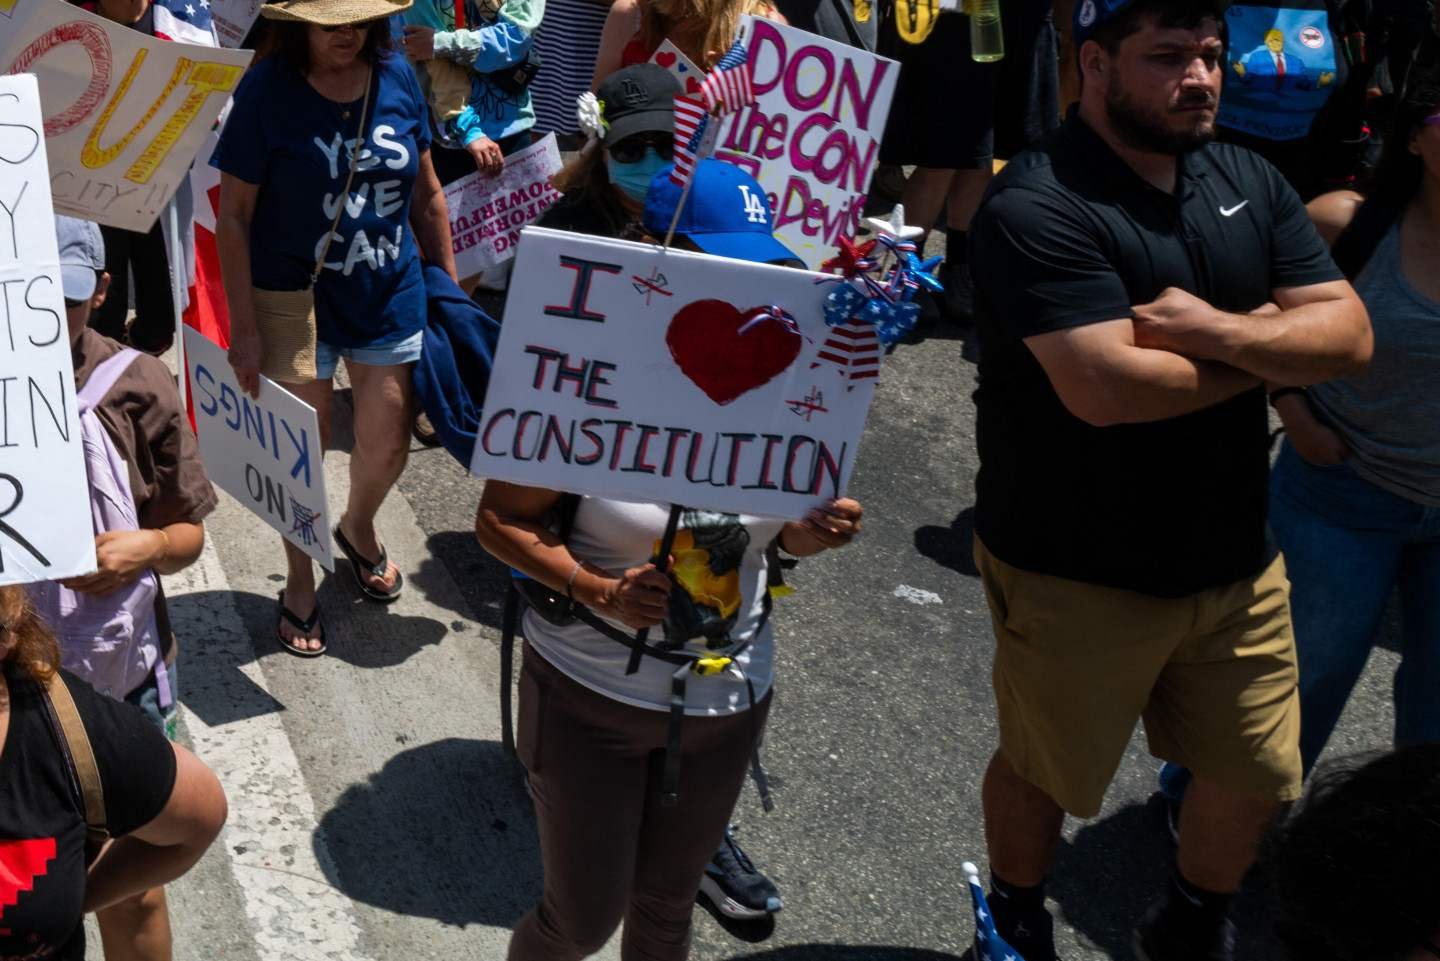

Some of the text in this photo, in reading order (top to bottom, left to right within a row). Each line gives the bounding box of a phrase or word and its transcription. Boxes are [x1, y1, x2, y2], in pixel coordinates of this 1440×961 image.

[7, 20, 246, 184] OUT
[747, 19, 892, 131] DON
[312, 123, 410, 180] YES
[788, 112, 879, 195] CON
[323, 179, 405, 220] WE
[740, 184, 767, 224] LA
[313, 224, 402, 278] CAN
[543, 254, 624, 323] I
[523, 344, 619, 409] THE
[195, 363, 312, 490] KINGS
[479, 407, 847, 500] CONSTITUTION
[244, 462, 288, 524] NO
